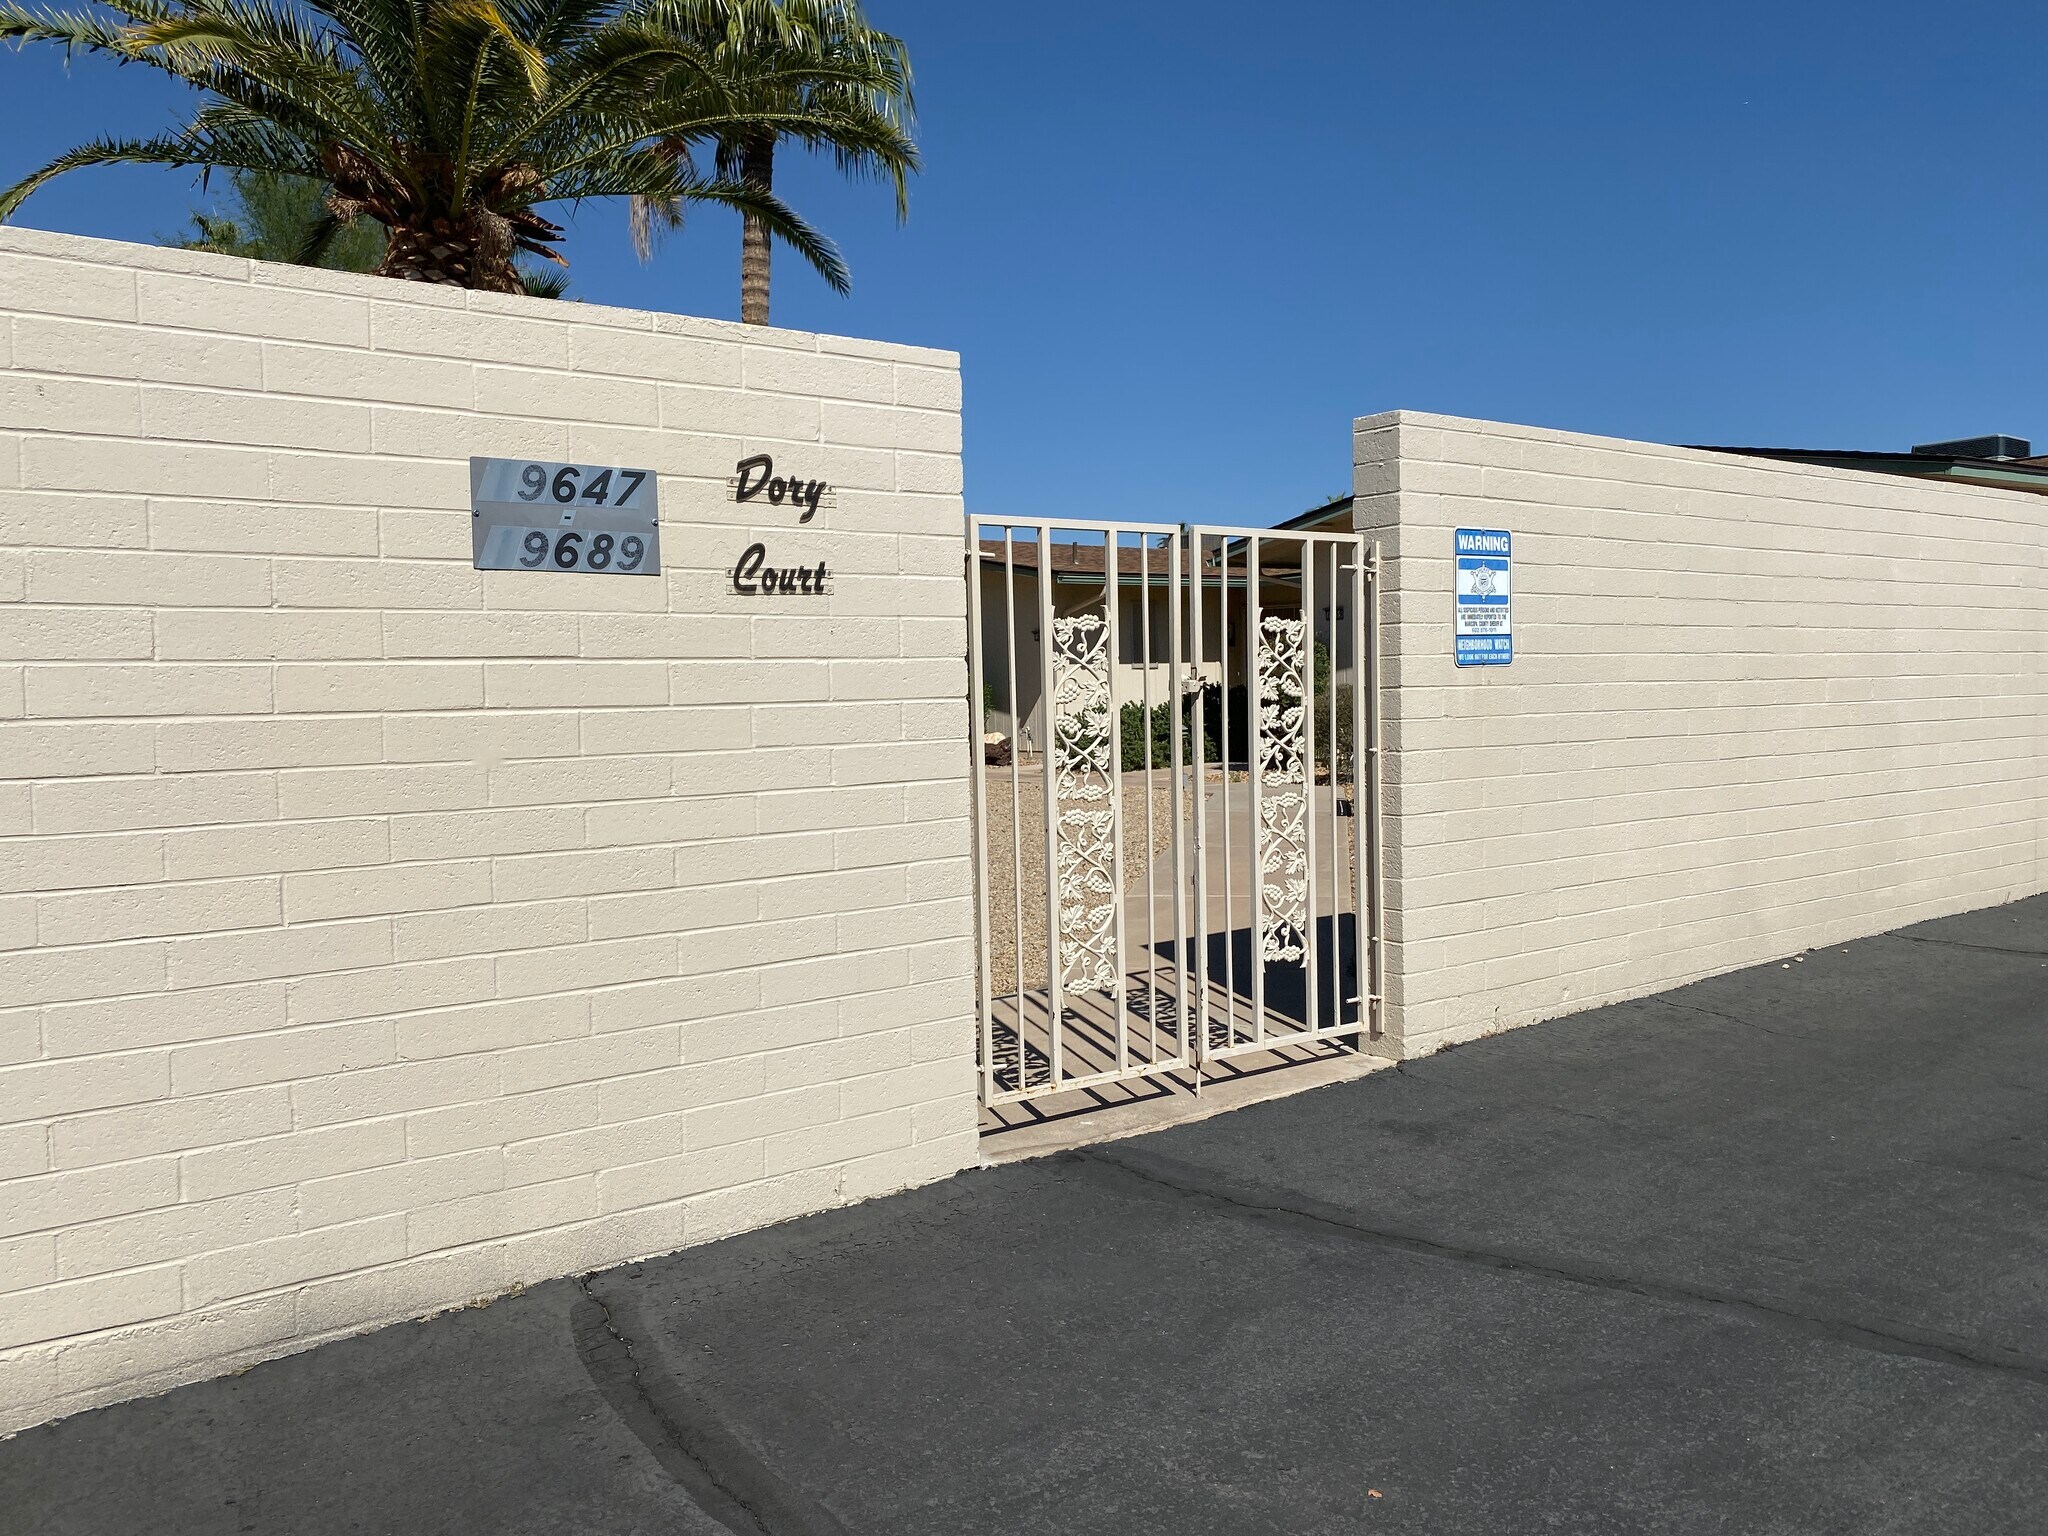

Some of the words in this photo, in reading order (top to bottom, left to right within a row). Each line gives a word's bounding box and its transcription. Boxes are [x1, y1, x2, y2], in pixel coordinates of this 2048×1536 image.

[517, 464, 647, 507] 9647
[736, 454, 827, 524] Dory
[519, 530, 644, 572] 9689
[1458, 534, 1509, 552] WARNING
[733, 543, 827, 595] Court
[1458, 639, 1492, 650] NEIGHBORHOOD
[1494, 639, 1509, 650] WATCH
